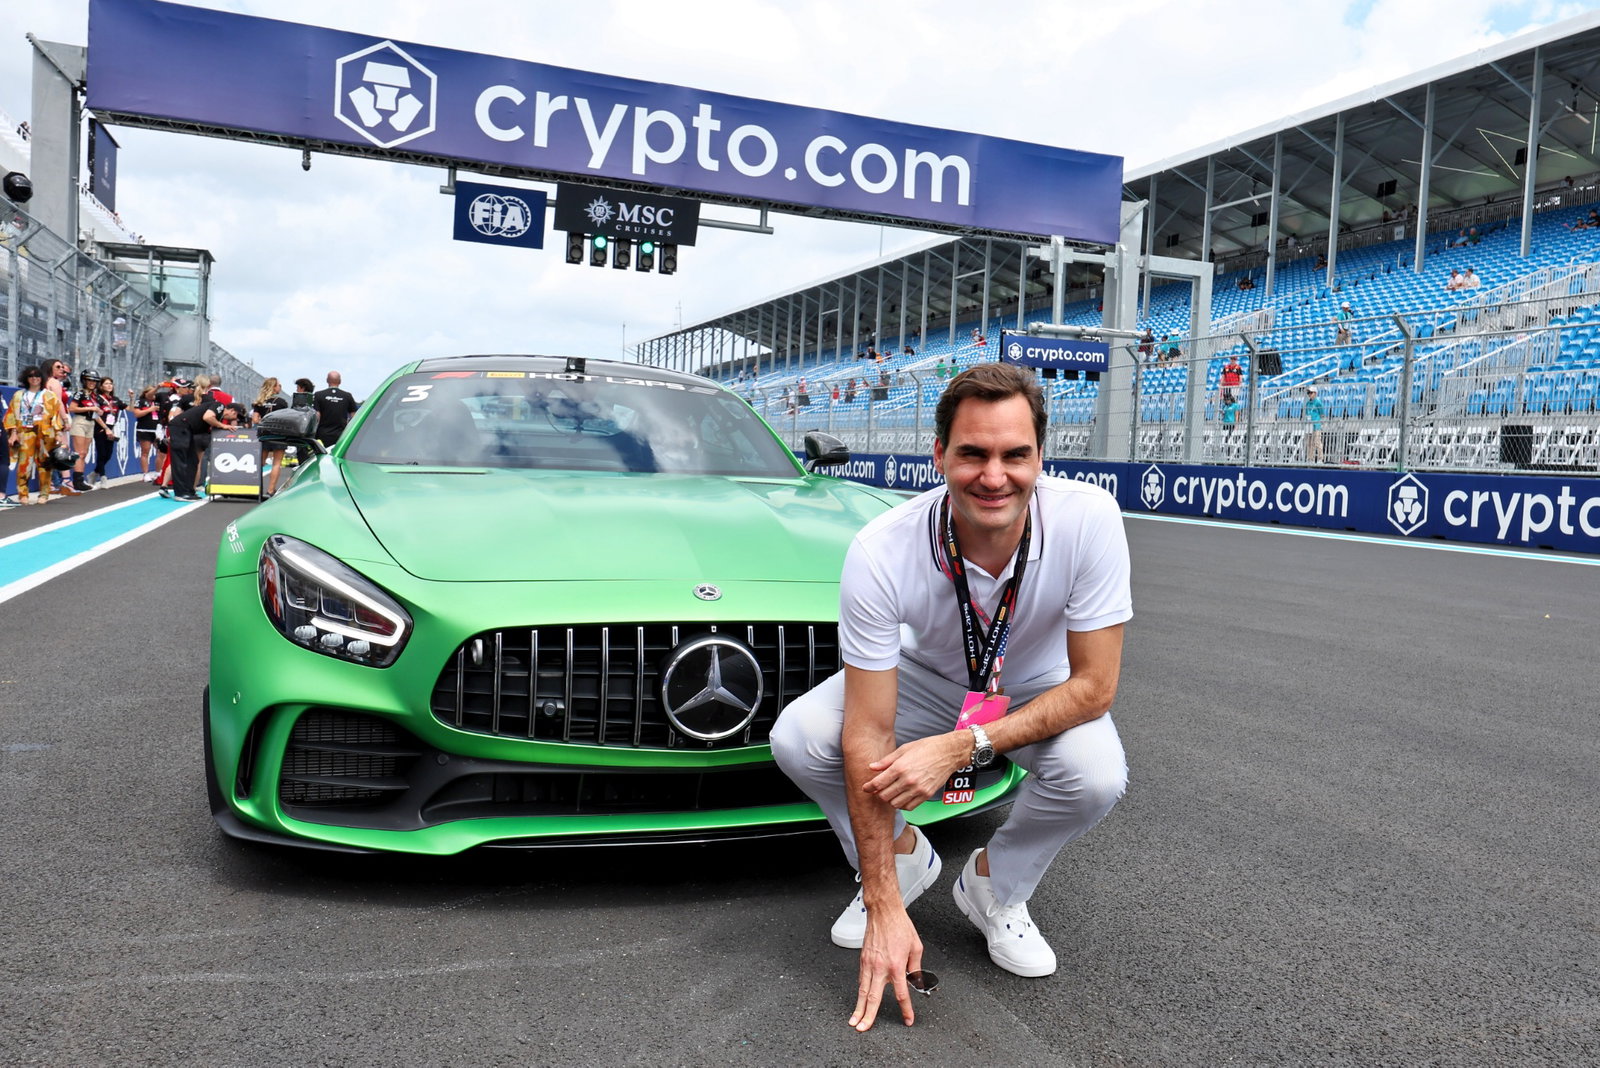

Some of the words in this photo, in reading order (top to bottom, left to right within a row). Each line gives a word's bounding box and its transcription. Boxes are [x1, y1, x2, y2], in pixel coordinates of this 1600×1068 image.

[474, 84, 971, 207] crypto.com
[616, 202, 674, 227] MSC
[615, 224, 673, 237] CRUISES
[1026, 346, 1105, 363] crypto.com
[401, 384, 434, 403] 3
[214, 452, 258, 474] 04
[899, 459, 944, 488] crypto.
[1173, 472, 1349, 518] crypto.com
[954, 777, 970, 789] 01
[944, 792, 973, 804] SUN
